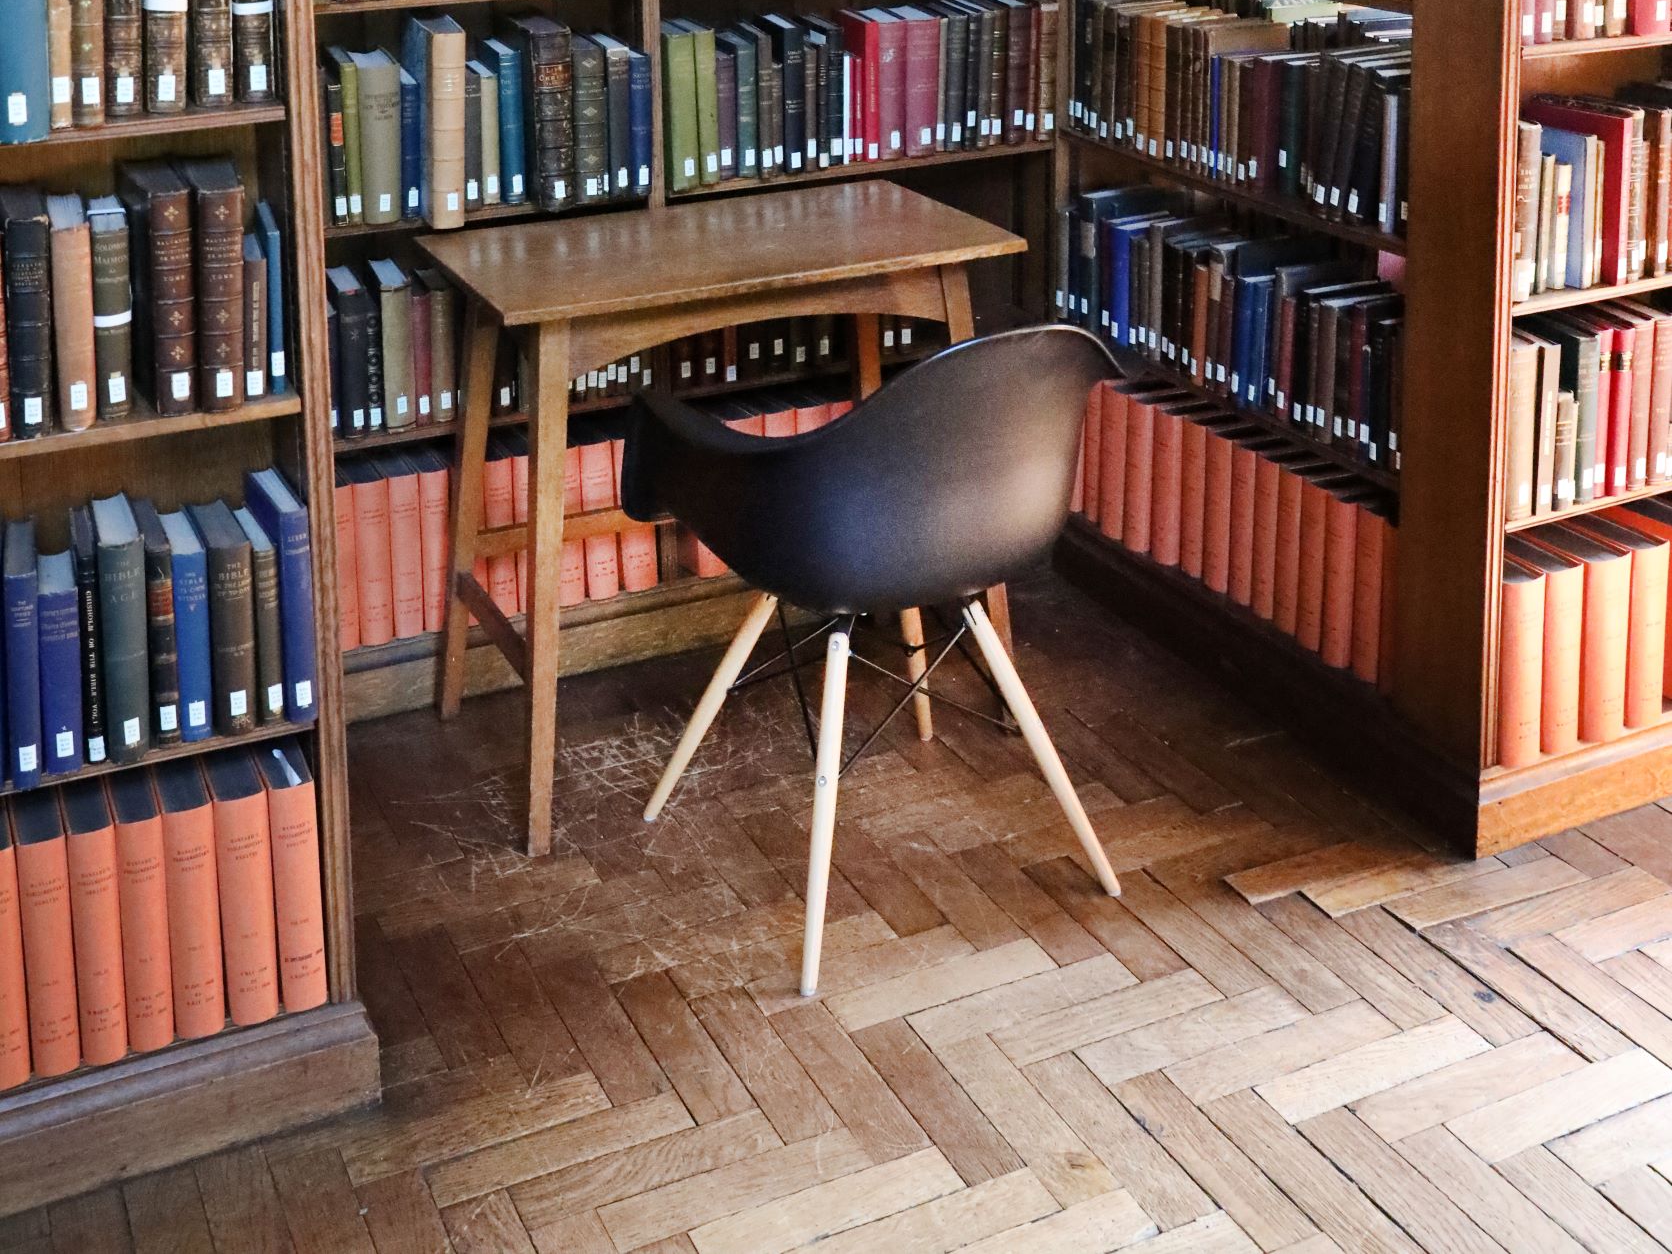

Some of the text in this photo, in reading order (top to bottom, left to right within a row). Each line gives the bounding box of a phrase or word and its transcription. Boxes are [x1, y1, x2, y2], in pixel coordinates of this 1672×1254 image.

[94, 254, 128, 265] MAIMON
[163, 274, 185, 282] TOME
[103, 566, 141, 582] BIBLE
[218, 568, 249, 581] BIBLE
[85, 590, 95, 631] CHISHOLM
[90, 673, 98, 696] BIBLE
